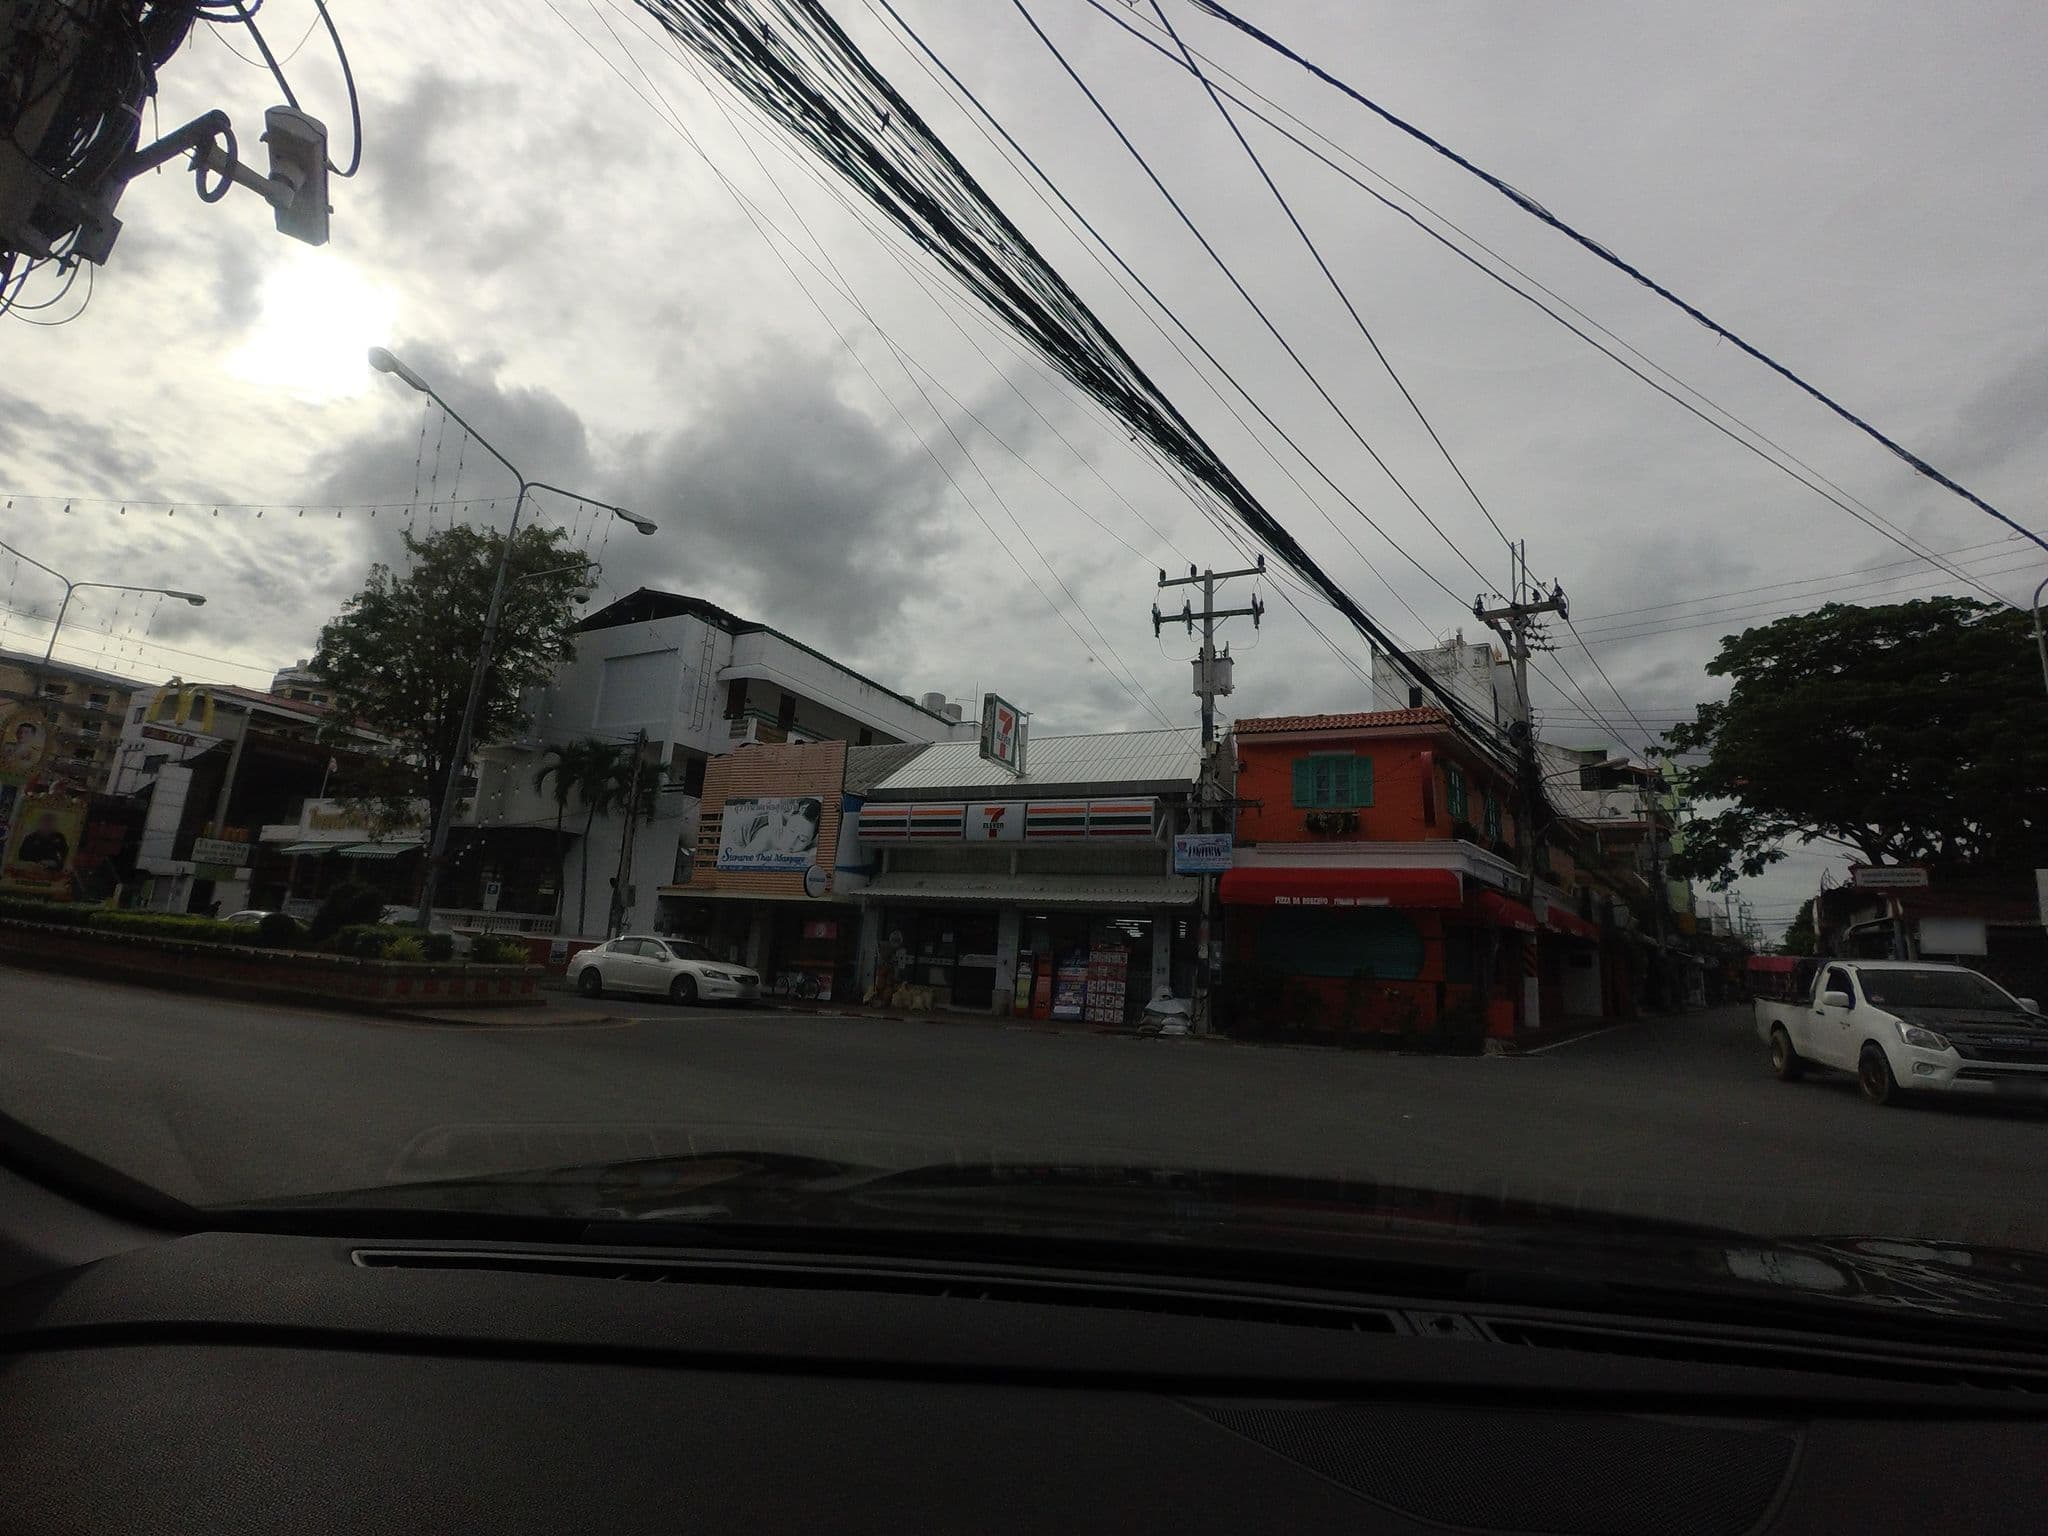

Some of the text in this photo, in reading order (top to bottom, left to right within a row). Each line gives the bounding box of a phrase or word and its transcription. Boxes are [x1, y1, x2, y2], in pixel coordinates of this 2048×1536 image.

[998, 708, 1013, 759] 7
[984, 807, 1005, 837] 7
[1274, 896, 1291, 905] PIZZA
